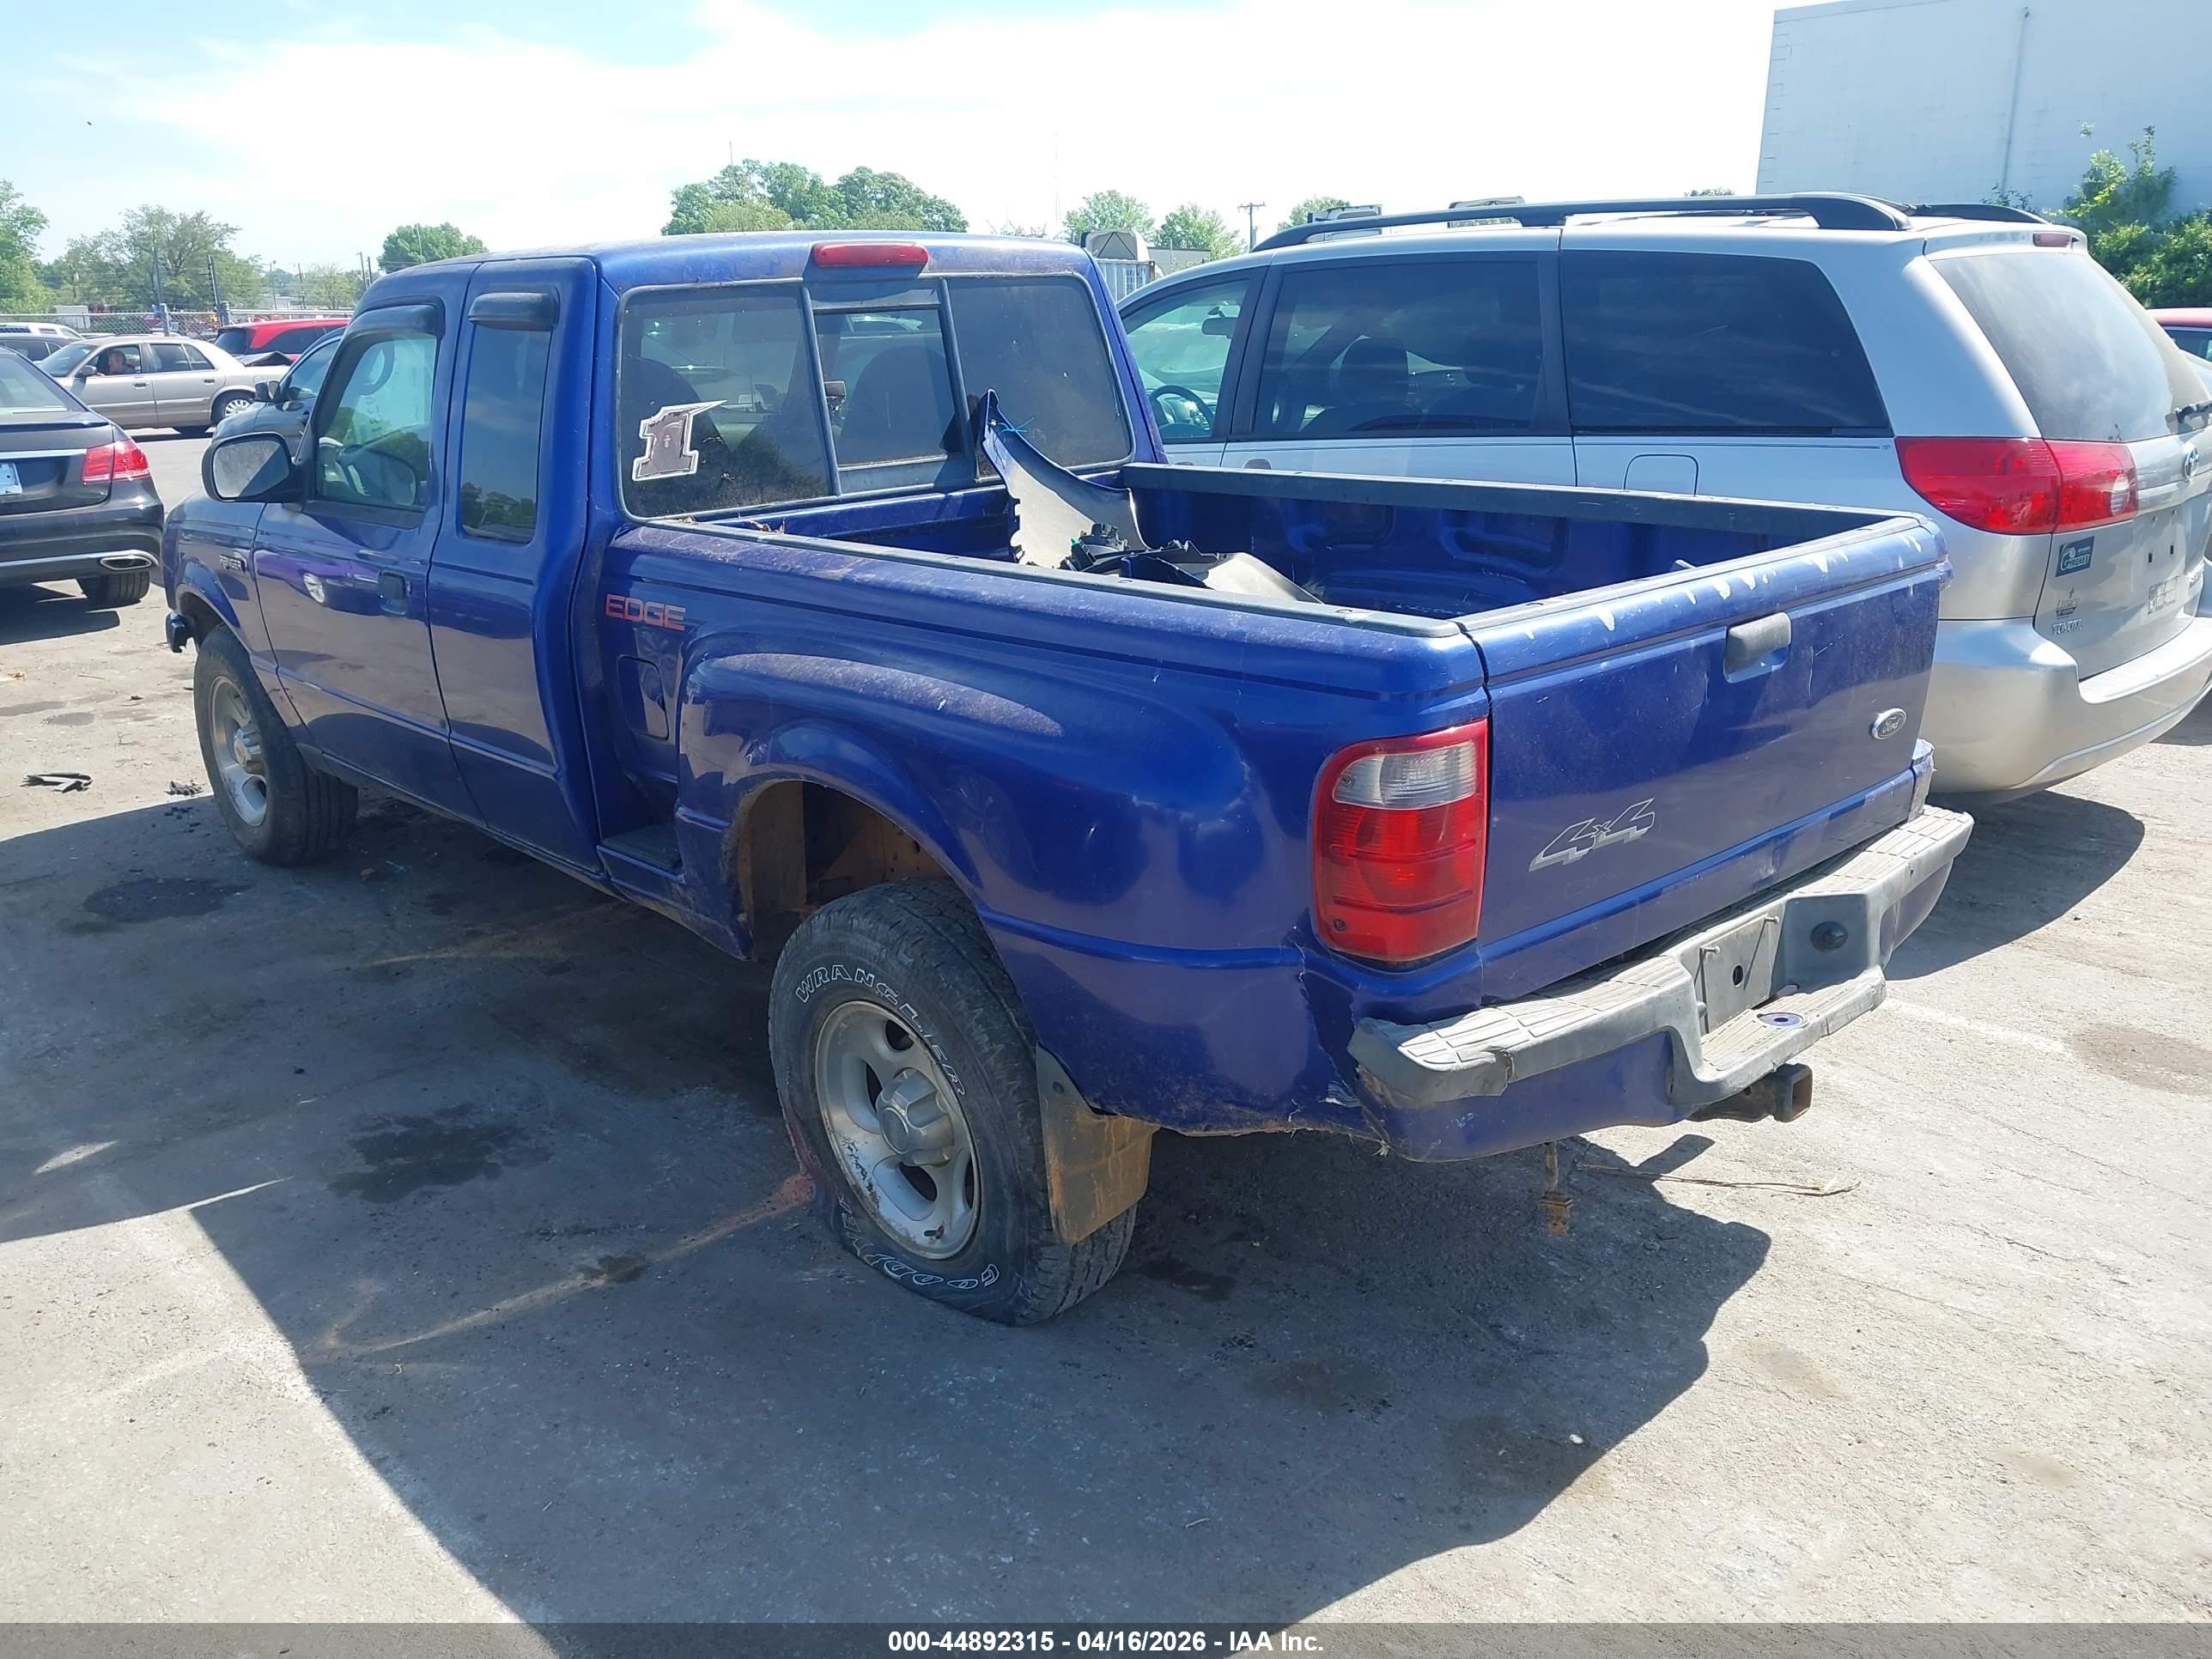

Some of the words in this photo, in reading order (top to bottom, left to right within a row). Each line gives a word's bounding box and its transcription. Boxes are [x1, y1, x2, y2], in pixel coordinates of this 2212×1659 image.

[605, 593, 687, 632] EDGE
[1882, 716, 1900, 734] Ford
[795, 964, 965, 1096] WRANGLER
[836, 1190, 1000, 1289] GOODYEA
